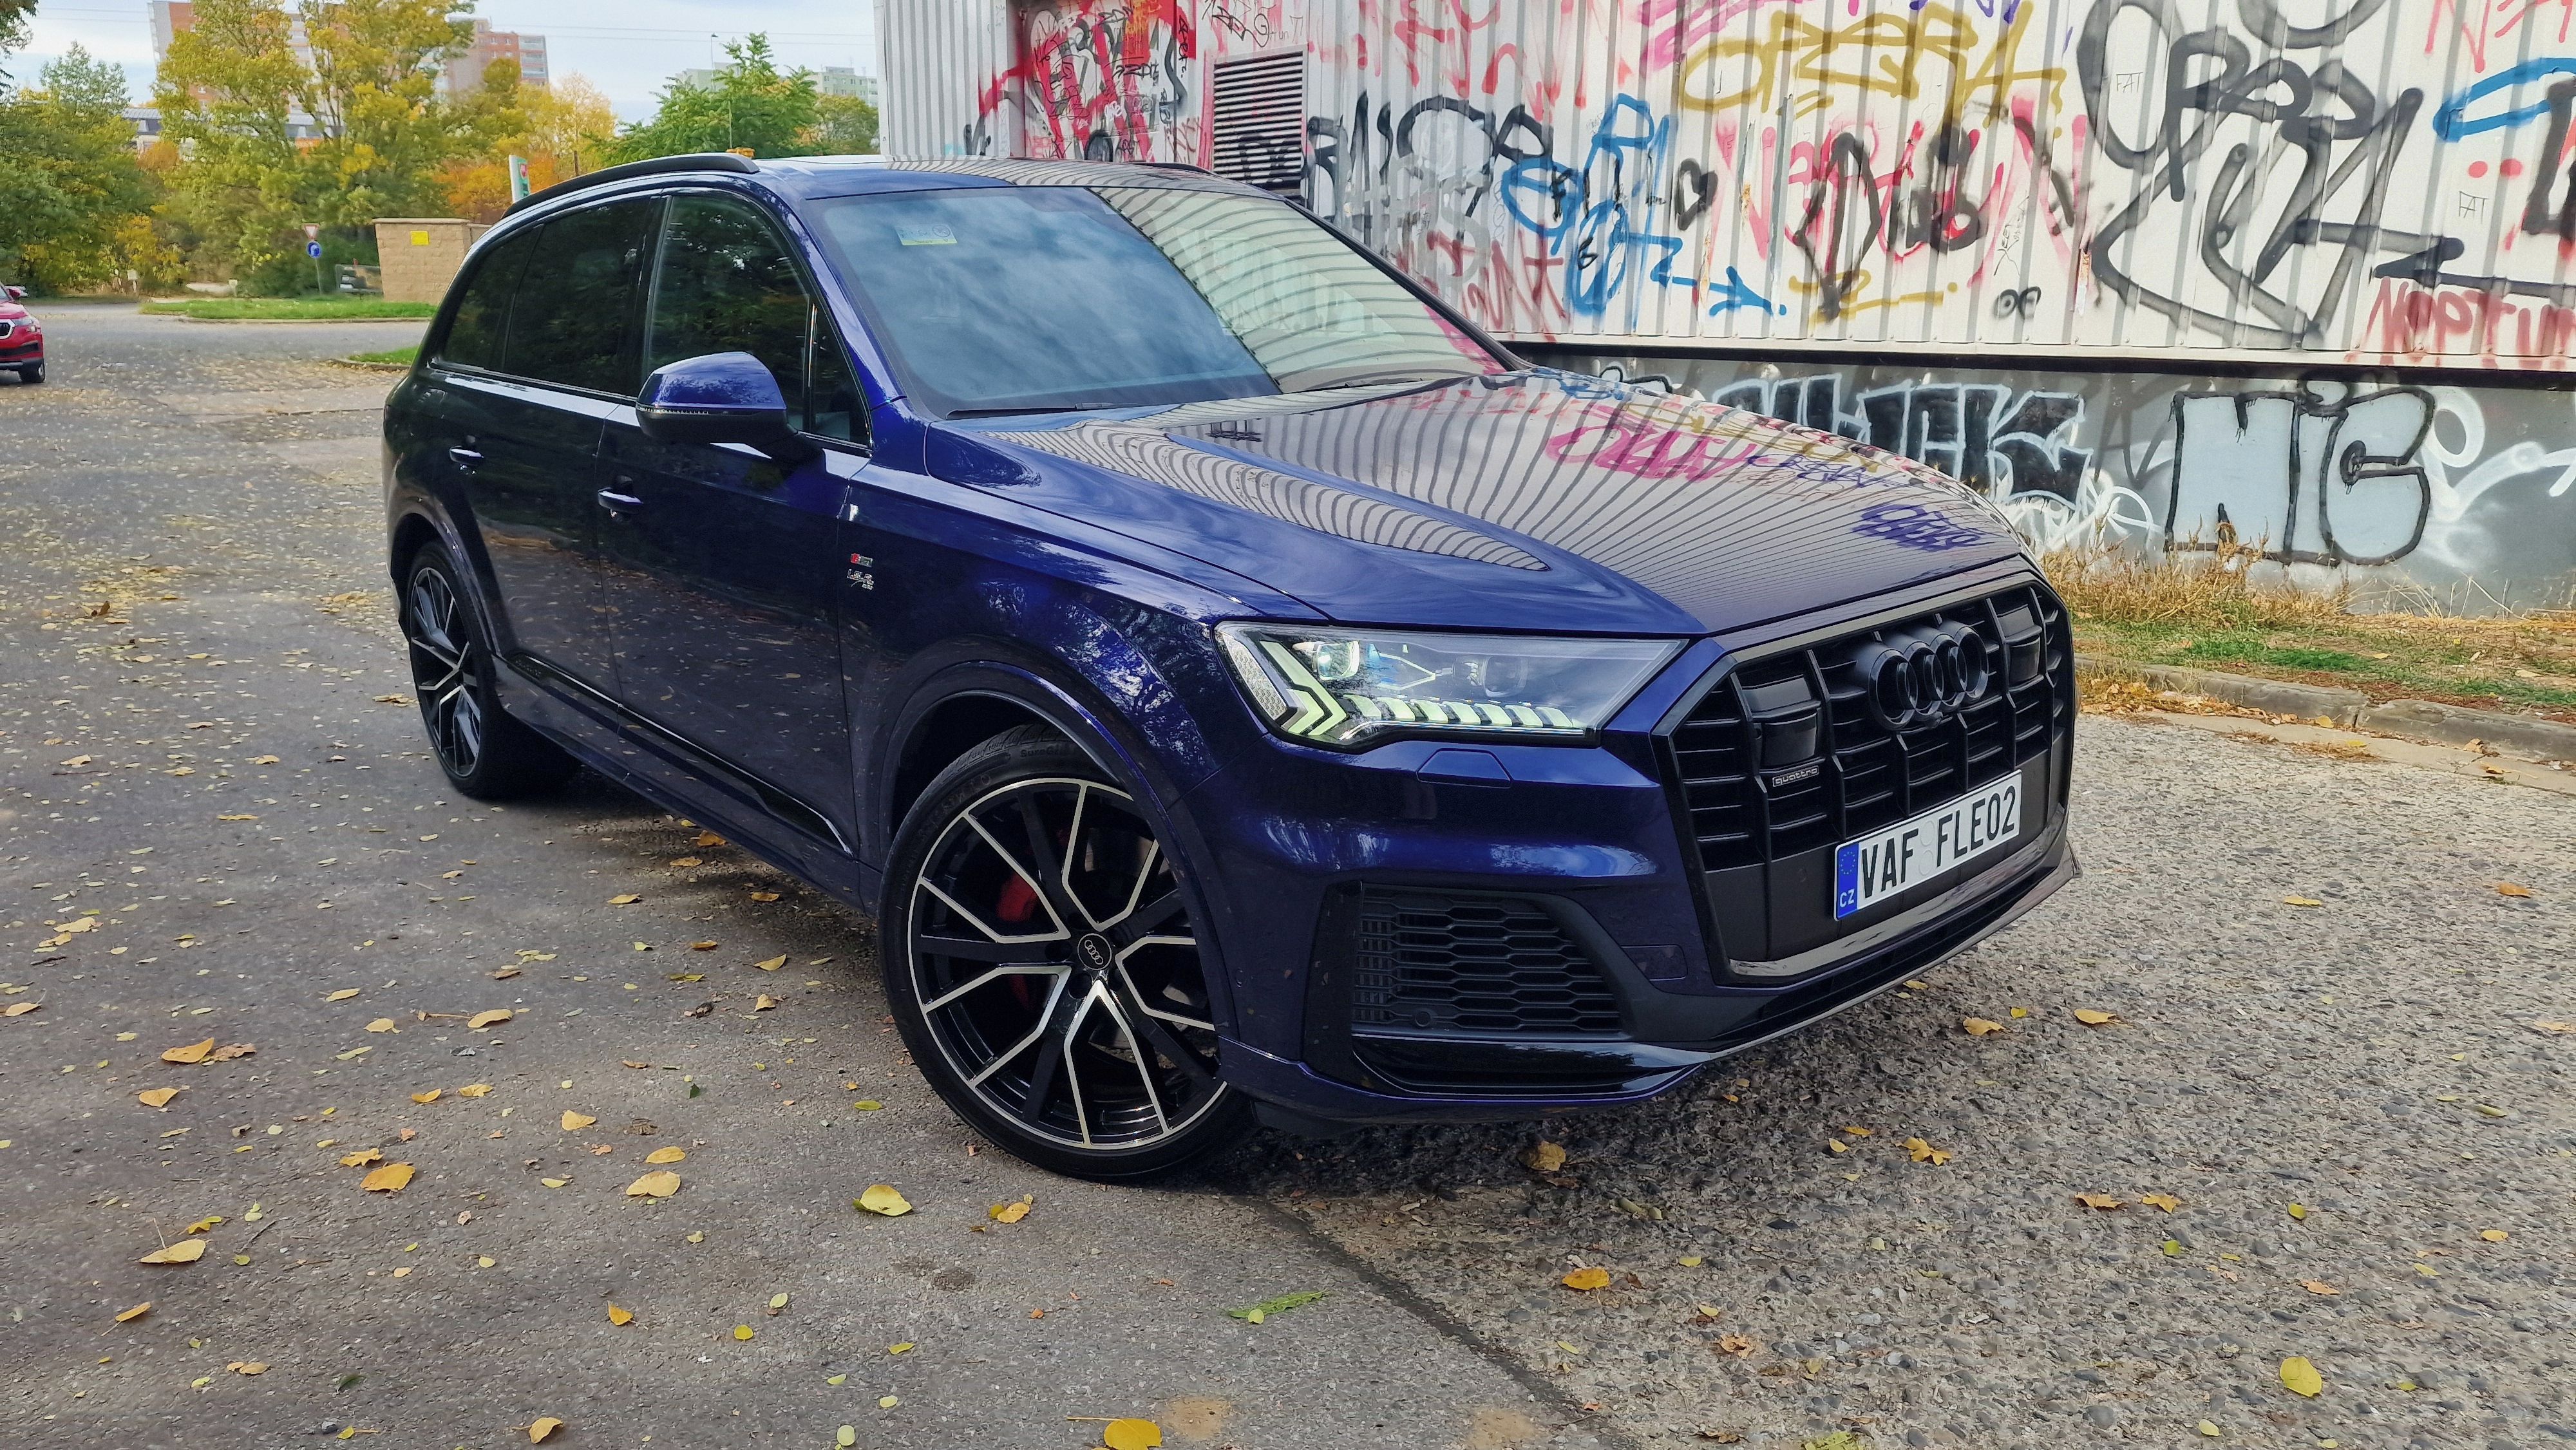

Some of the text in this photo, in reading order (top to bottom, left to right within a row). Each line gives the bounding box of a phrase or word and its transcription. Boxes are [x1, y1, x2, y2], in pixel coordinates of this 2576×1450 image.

[1774, 767, 1818, 785] quattro
[1861, 785, 2016, 899] VAF FLE02
[1839, 889, 1855, 908] CZ
